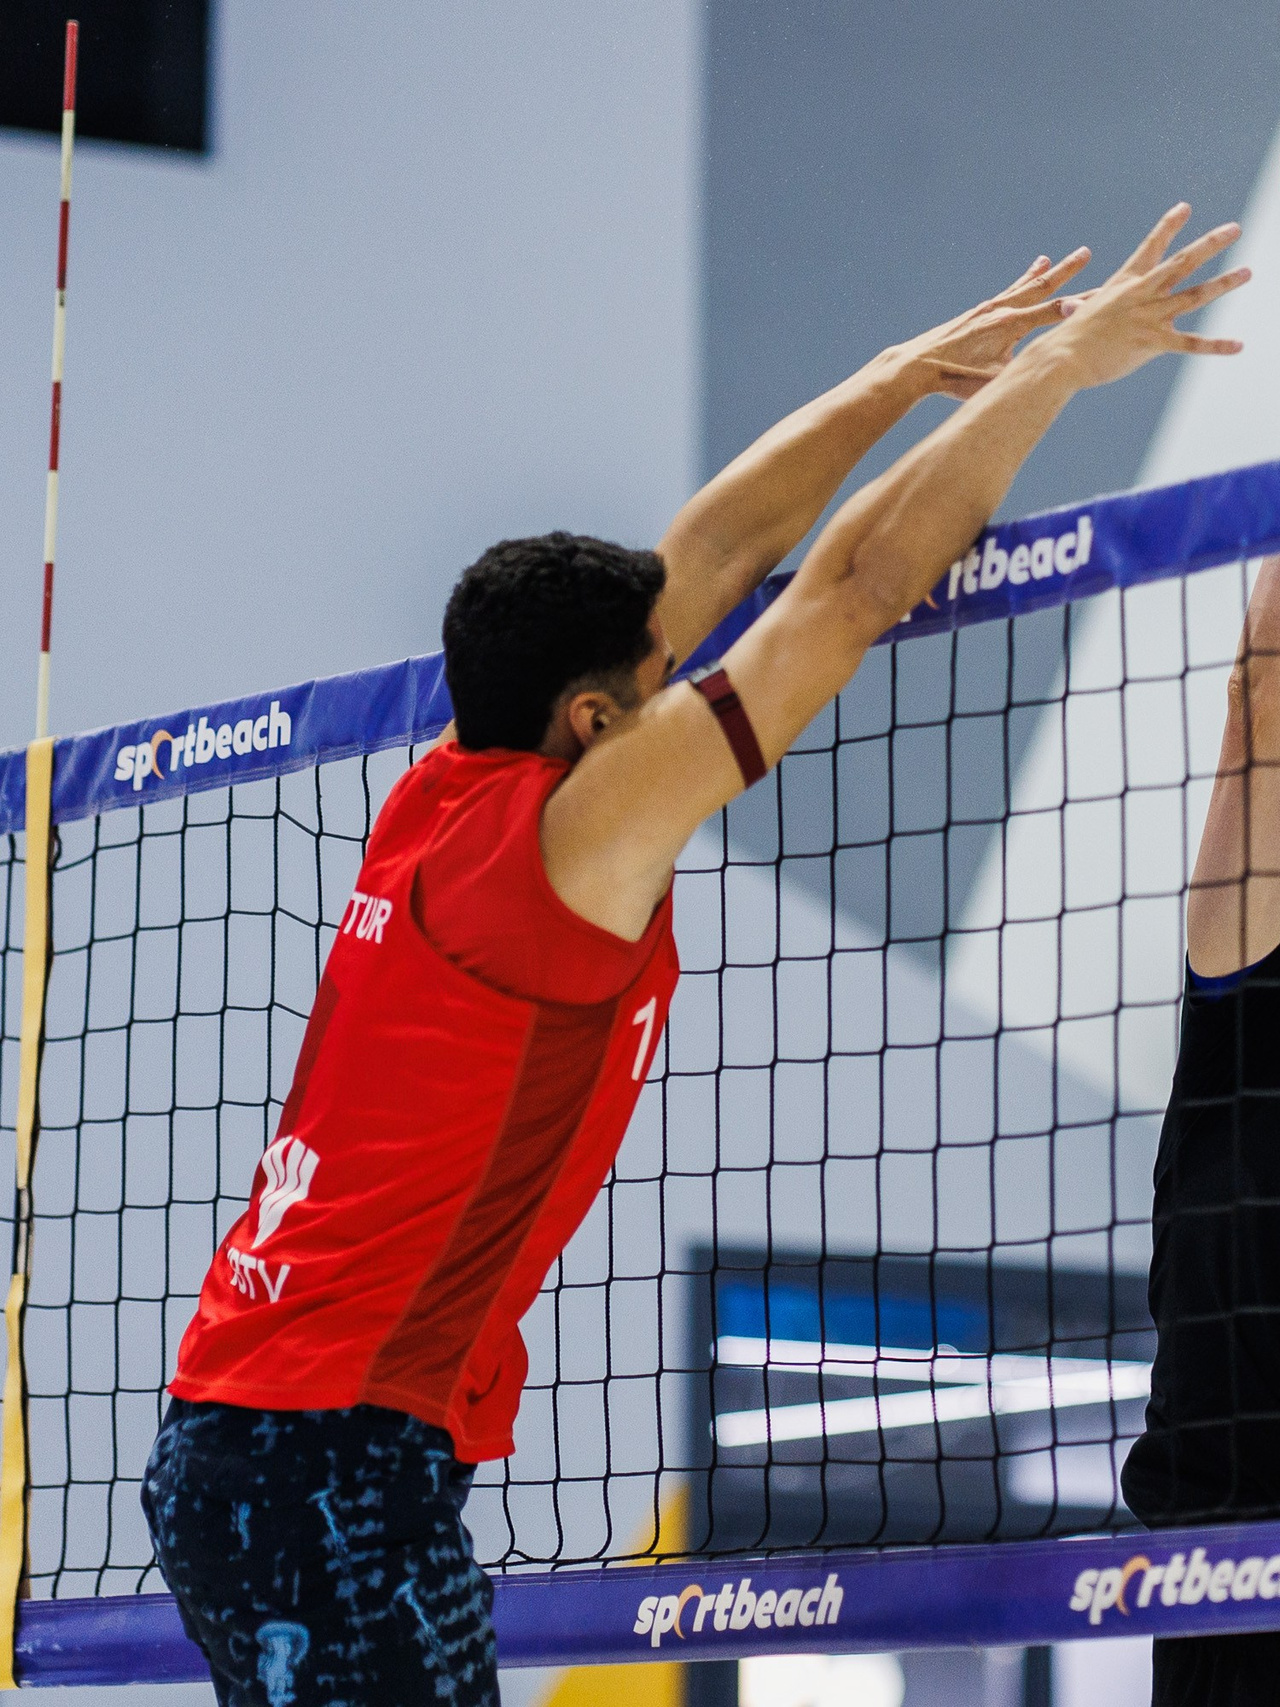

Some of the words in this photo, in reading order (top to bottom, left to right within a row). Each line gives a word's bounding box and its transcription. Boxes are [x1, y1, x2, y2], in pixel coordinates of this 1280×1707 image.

[114, 700, 291, 791] sportbeach
[343, 891, 393, 944] TUR
[632, 997, 656, 1081] 1
[633, 1573, 843, 1648] sportbeach
